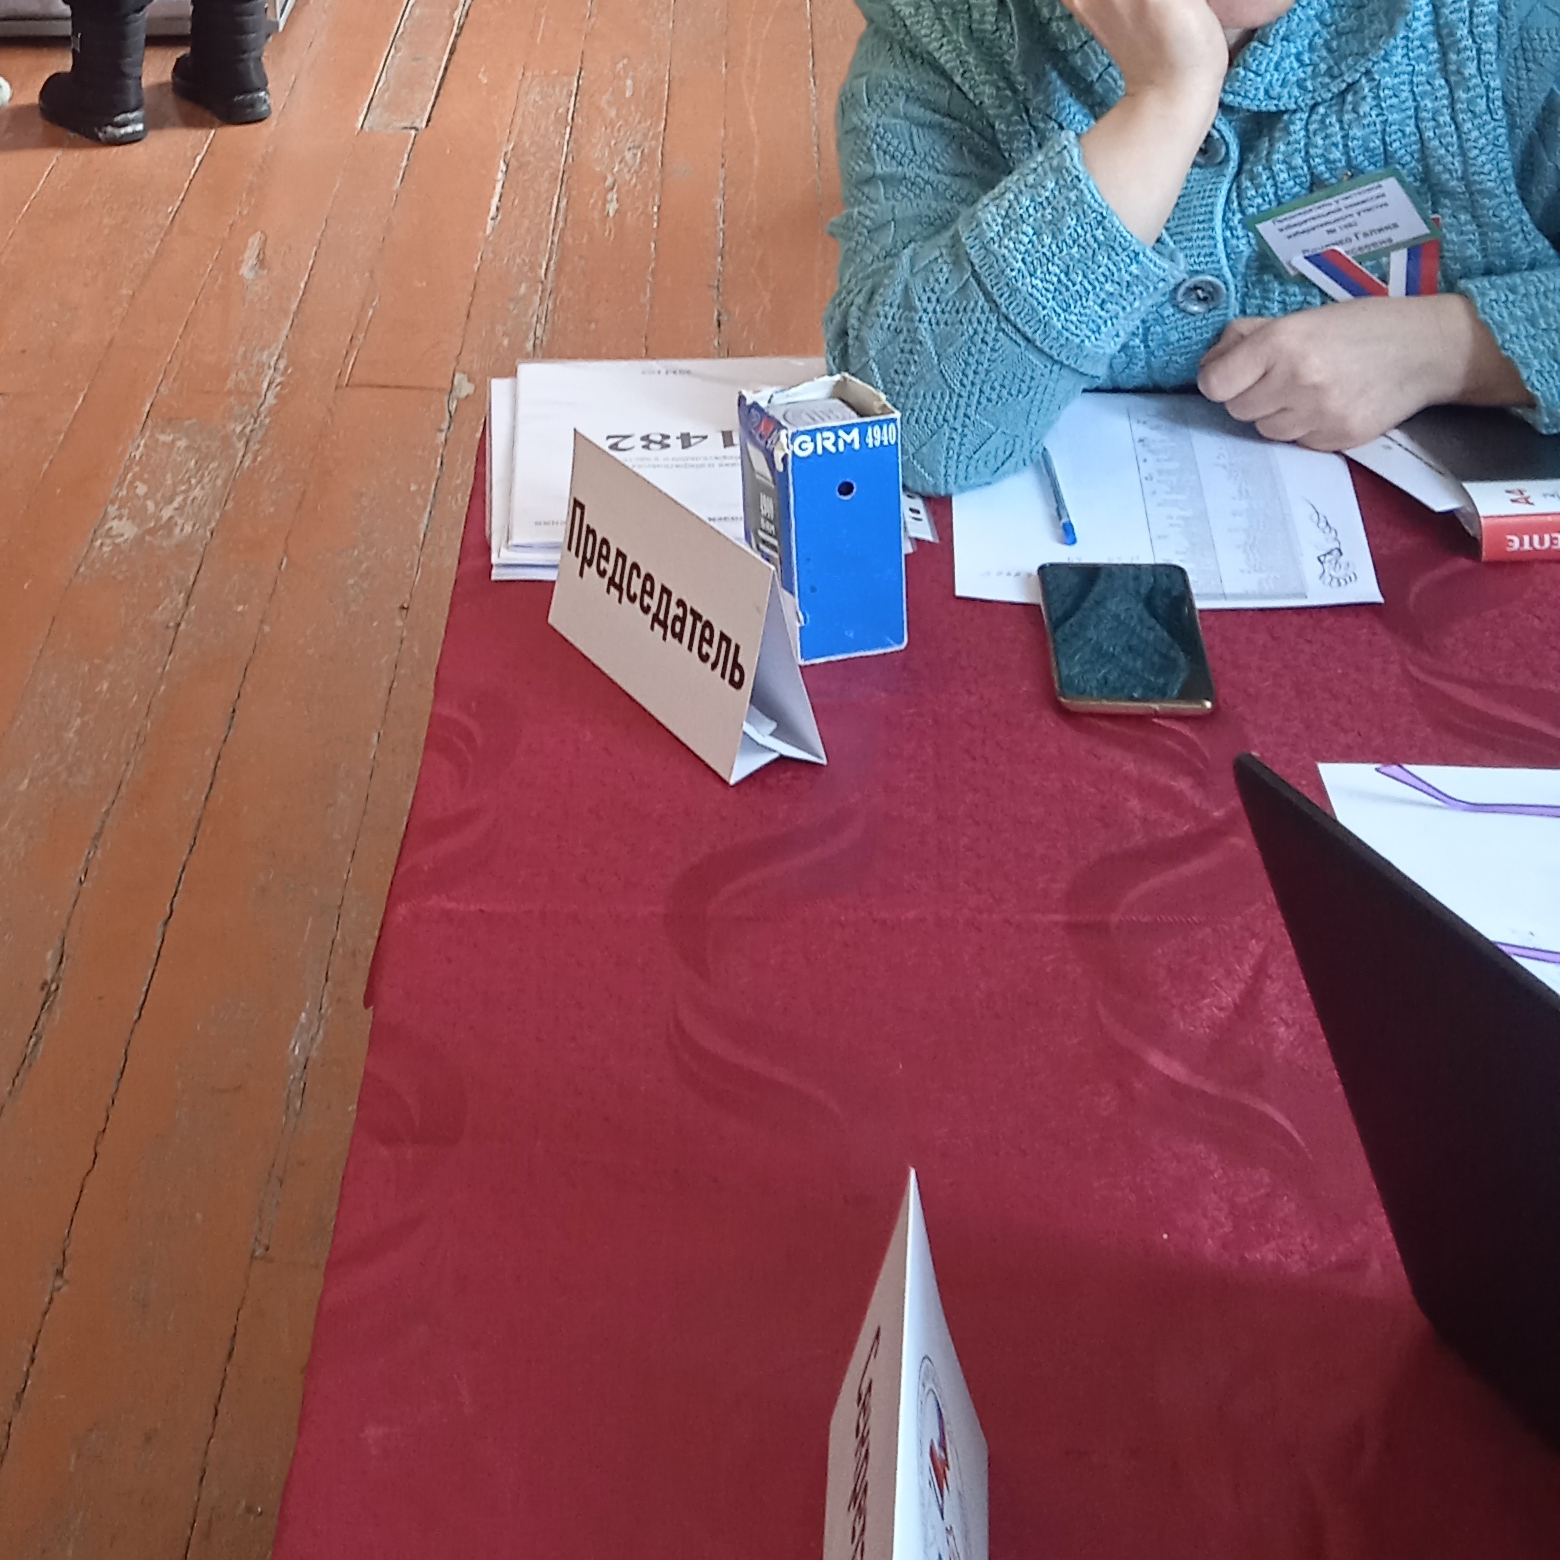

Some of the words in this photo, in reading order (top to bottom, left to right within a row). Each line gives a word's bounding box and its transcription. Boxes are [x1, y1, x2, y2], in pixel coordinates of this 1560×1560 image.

[605, 428, 740, 452] 1482
[793, 426, 861, 458] GRM
[865, 422, 897, 449] 4940
[567, 498, 745, 691] Председатель
